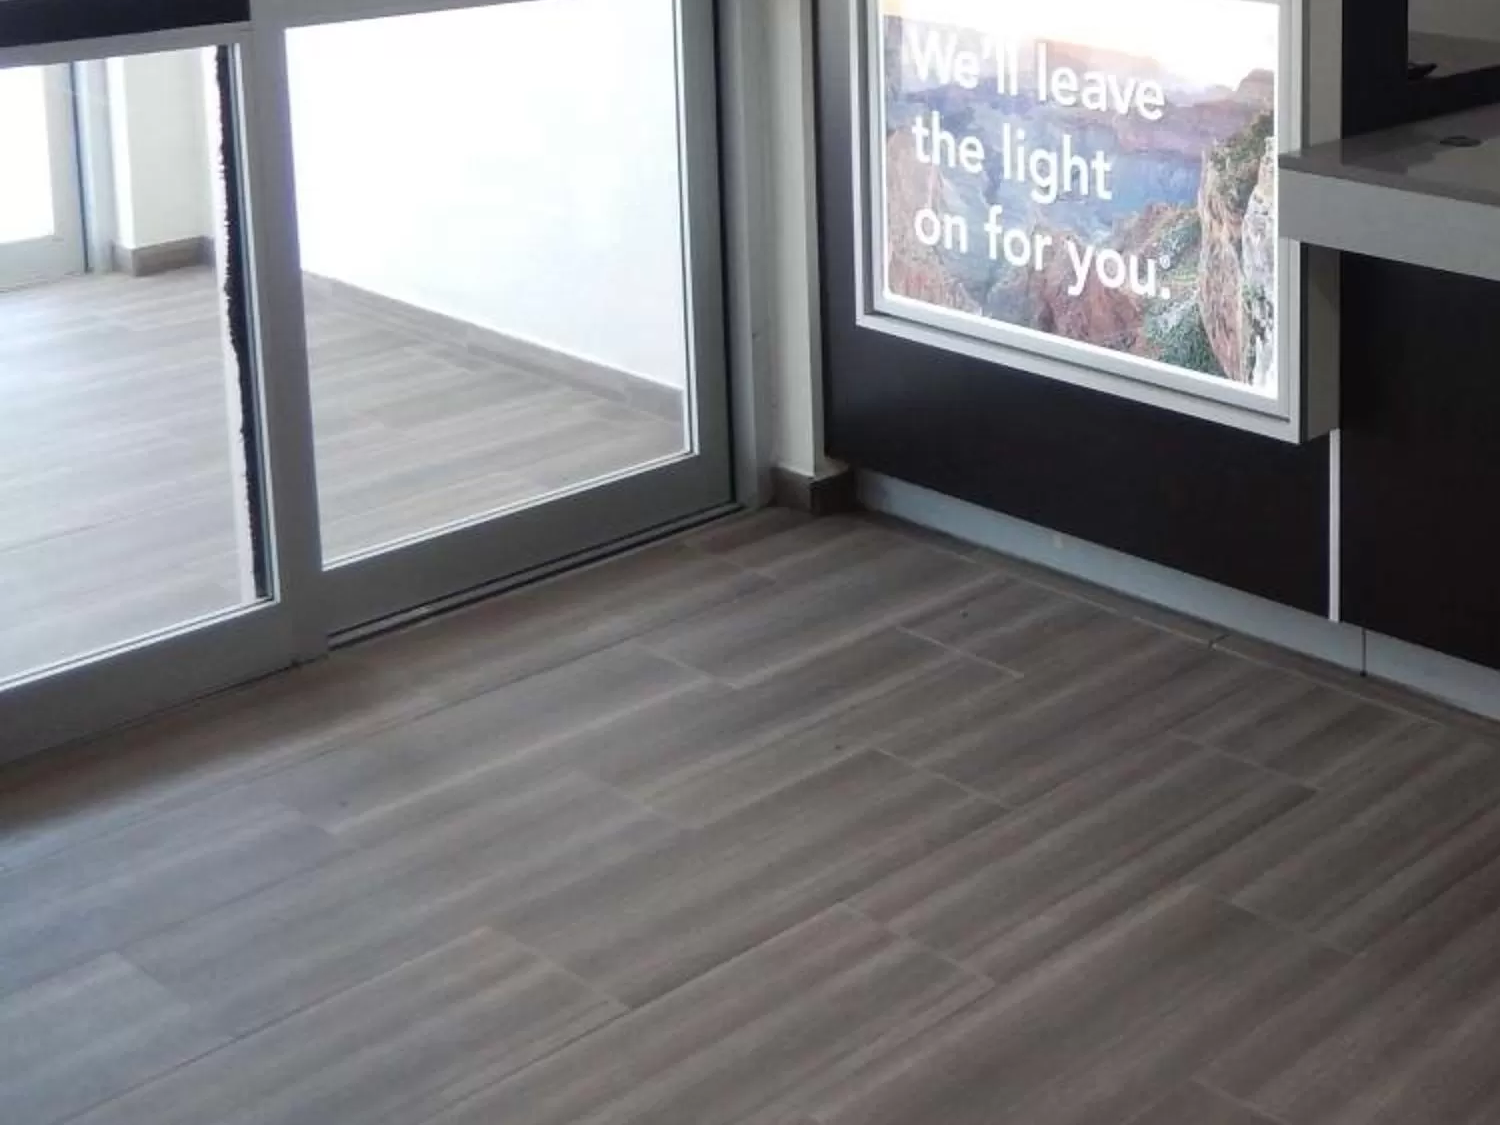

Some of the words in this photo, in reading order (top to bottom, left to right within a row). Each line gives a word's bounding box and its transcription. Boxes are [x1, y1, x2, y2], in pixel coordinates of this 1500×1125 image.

[906, 27, 1018, 96] We'll
[1037, 41, 1165, 121] leave
[911, 110, 985, 173] the
[1002, 122, 1112, 204] light
[914, 207, 968, 254] on
[984, 205, 1052, 271] for
